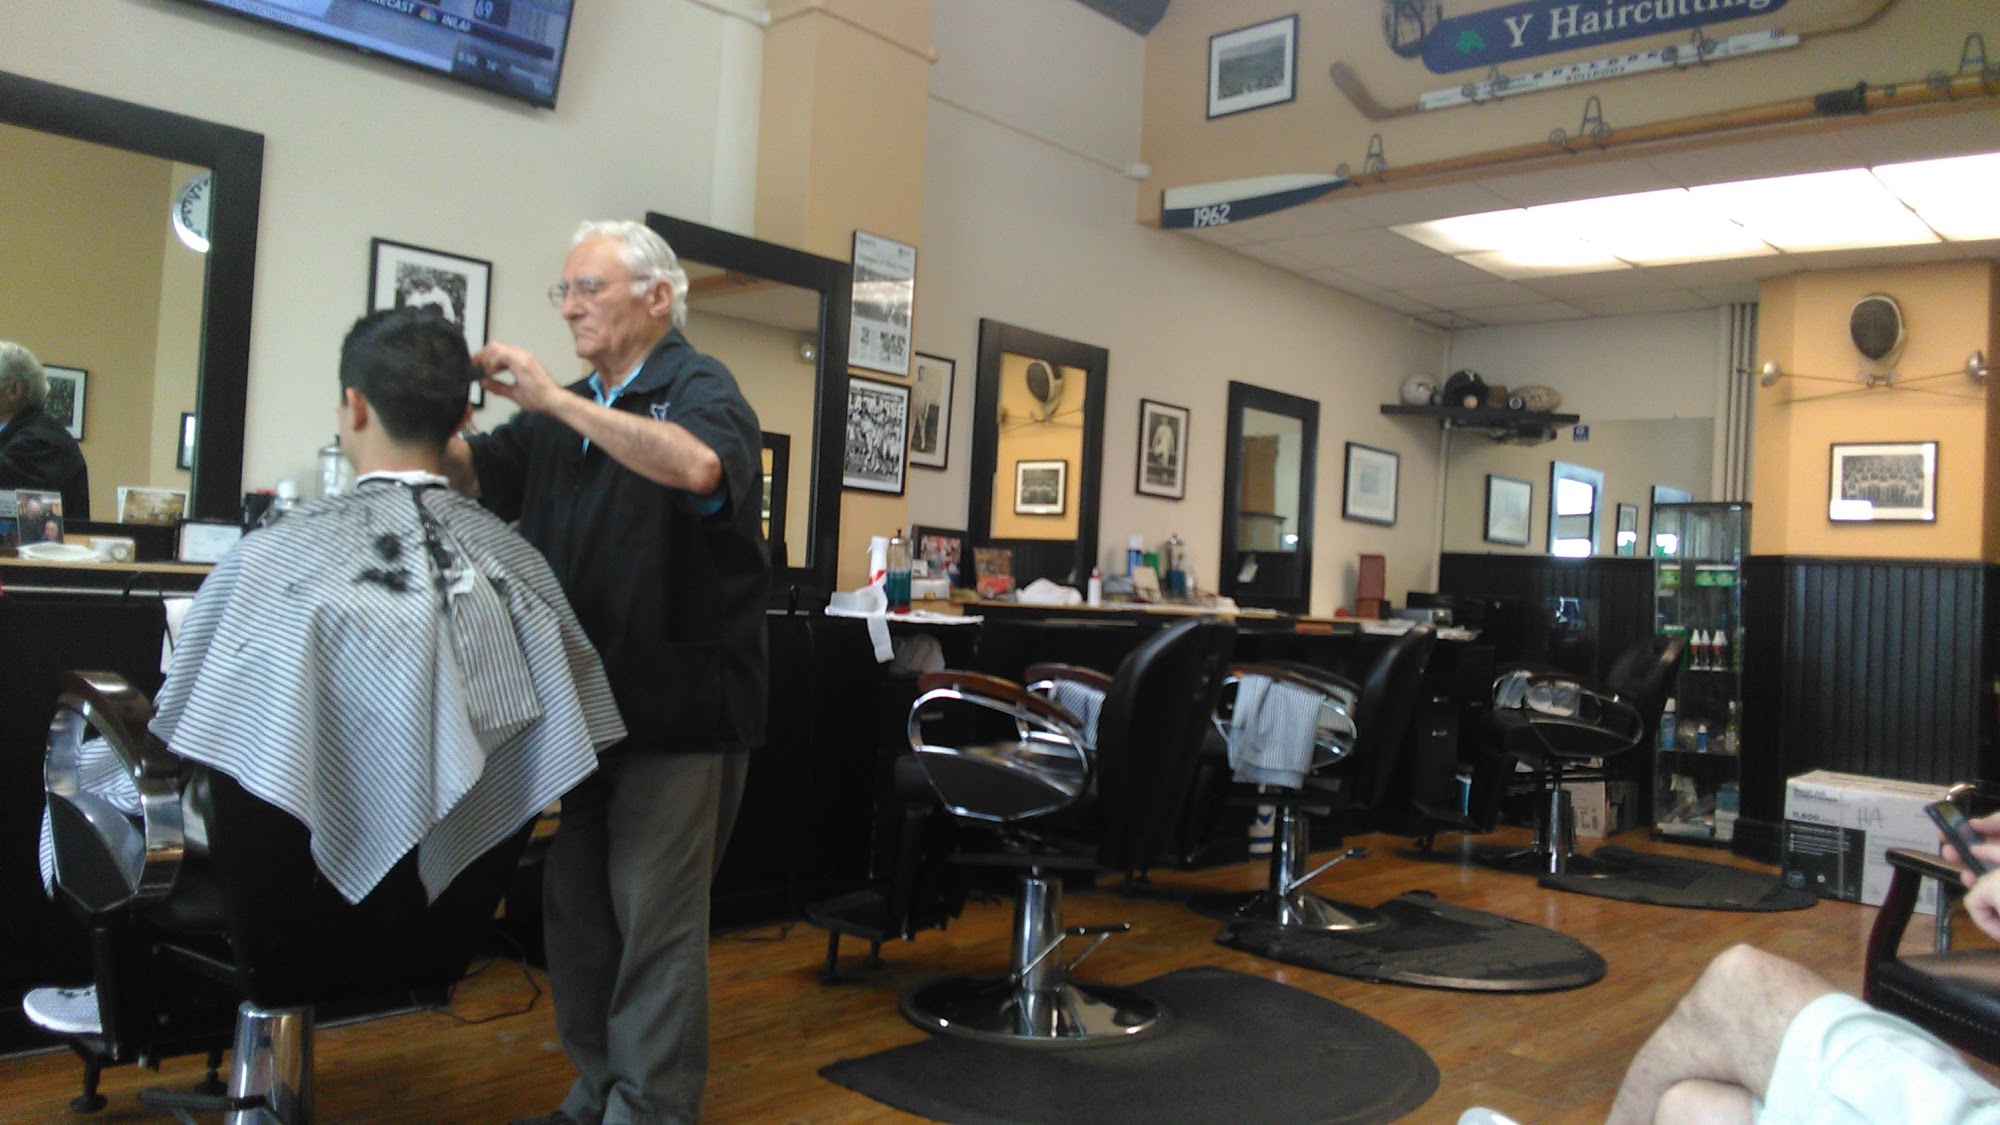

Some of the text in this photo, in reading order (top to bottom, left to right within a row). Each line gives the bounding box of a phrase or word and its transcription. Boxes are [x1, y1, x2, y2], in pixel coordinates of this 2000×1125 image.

[1504, 0, 1771, 48] Y Haircu
[1193, 204, 1231, 227] 1962
